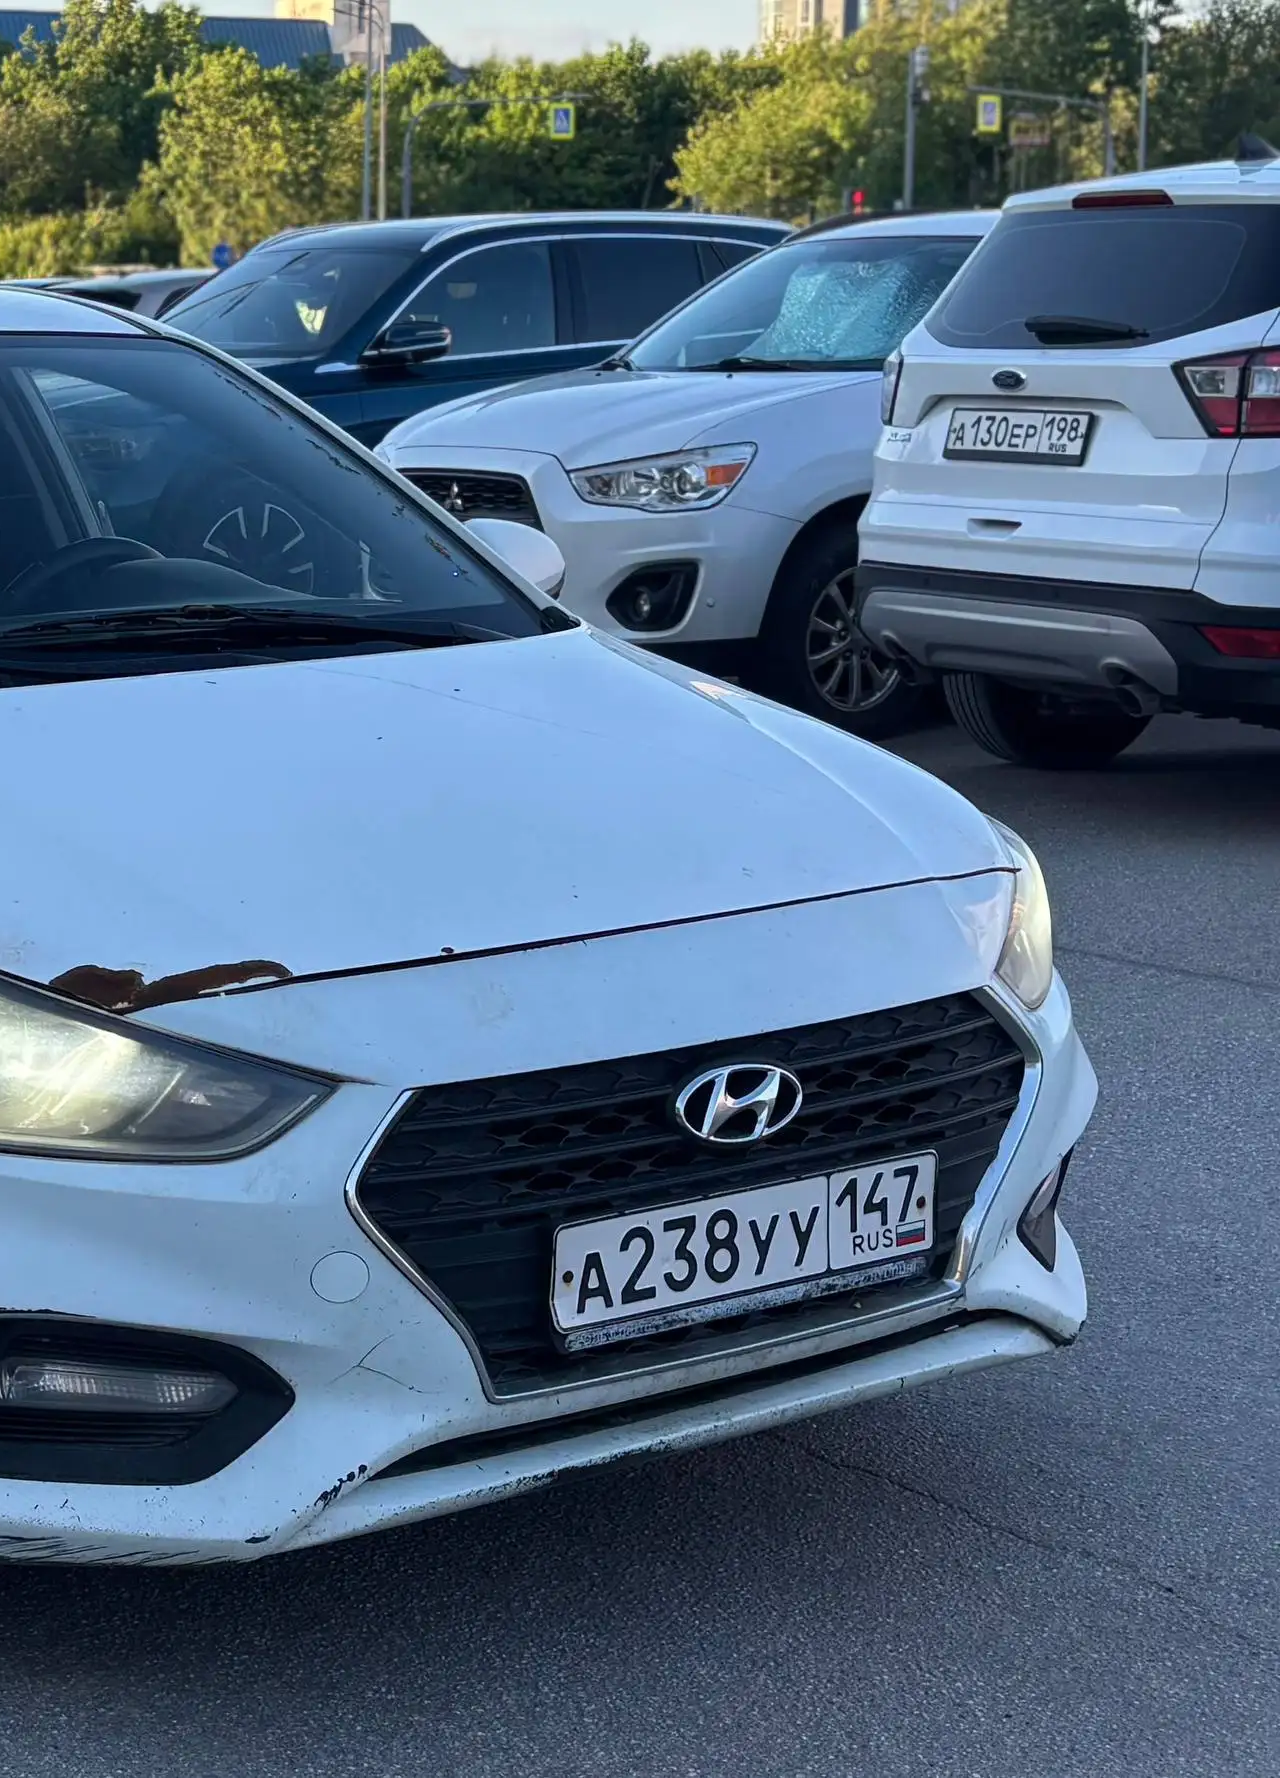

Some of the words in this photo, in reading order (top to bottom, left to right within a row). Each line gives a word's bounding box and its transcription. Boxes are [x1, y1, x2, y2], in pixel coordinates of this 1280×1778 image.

[953, 415, 1038, 449] А130ЕР
[1045, 416, 1080, 442] 198
[1048, 442, 1067, 453] RUS
[577, 1206, 820, 1315] А238УУ
[835, 1164, 919, 1233] 147
[853, 1229, 893, 1256] RUS
